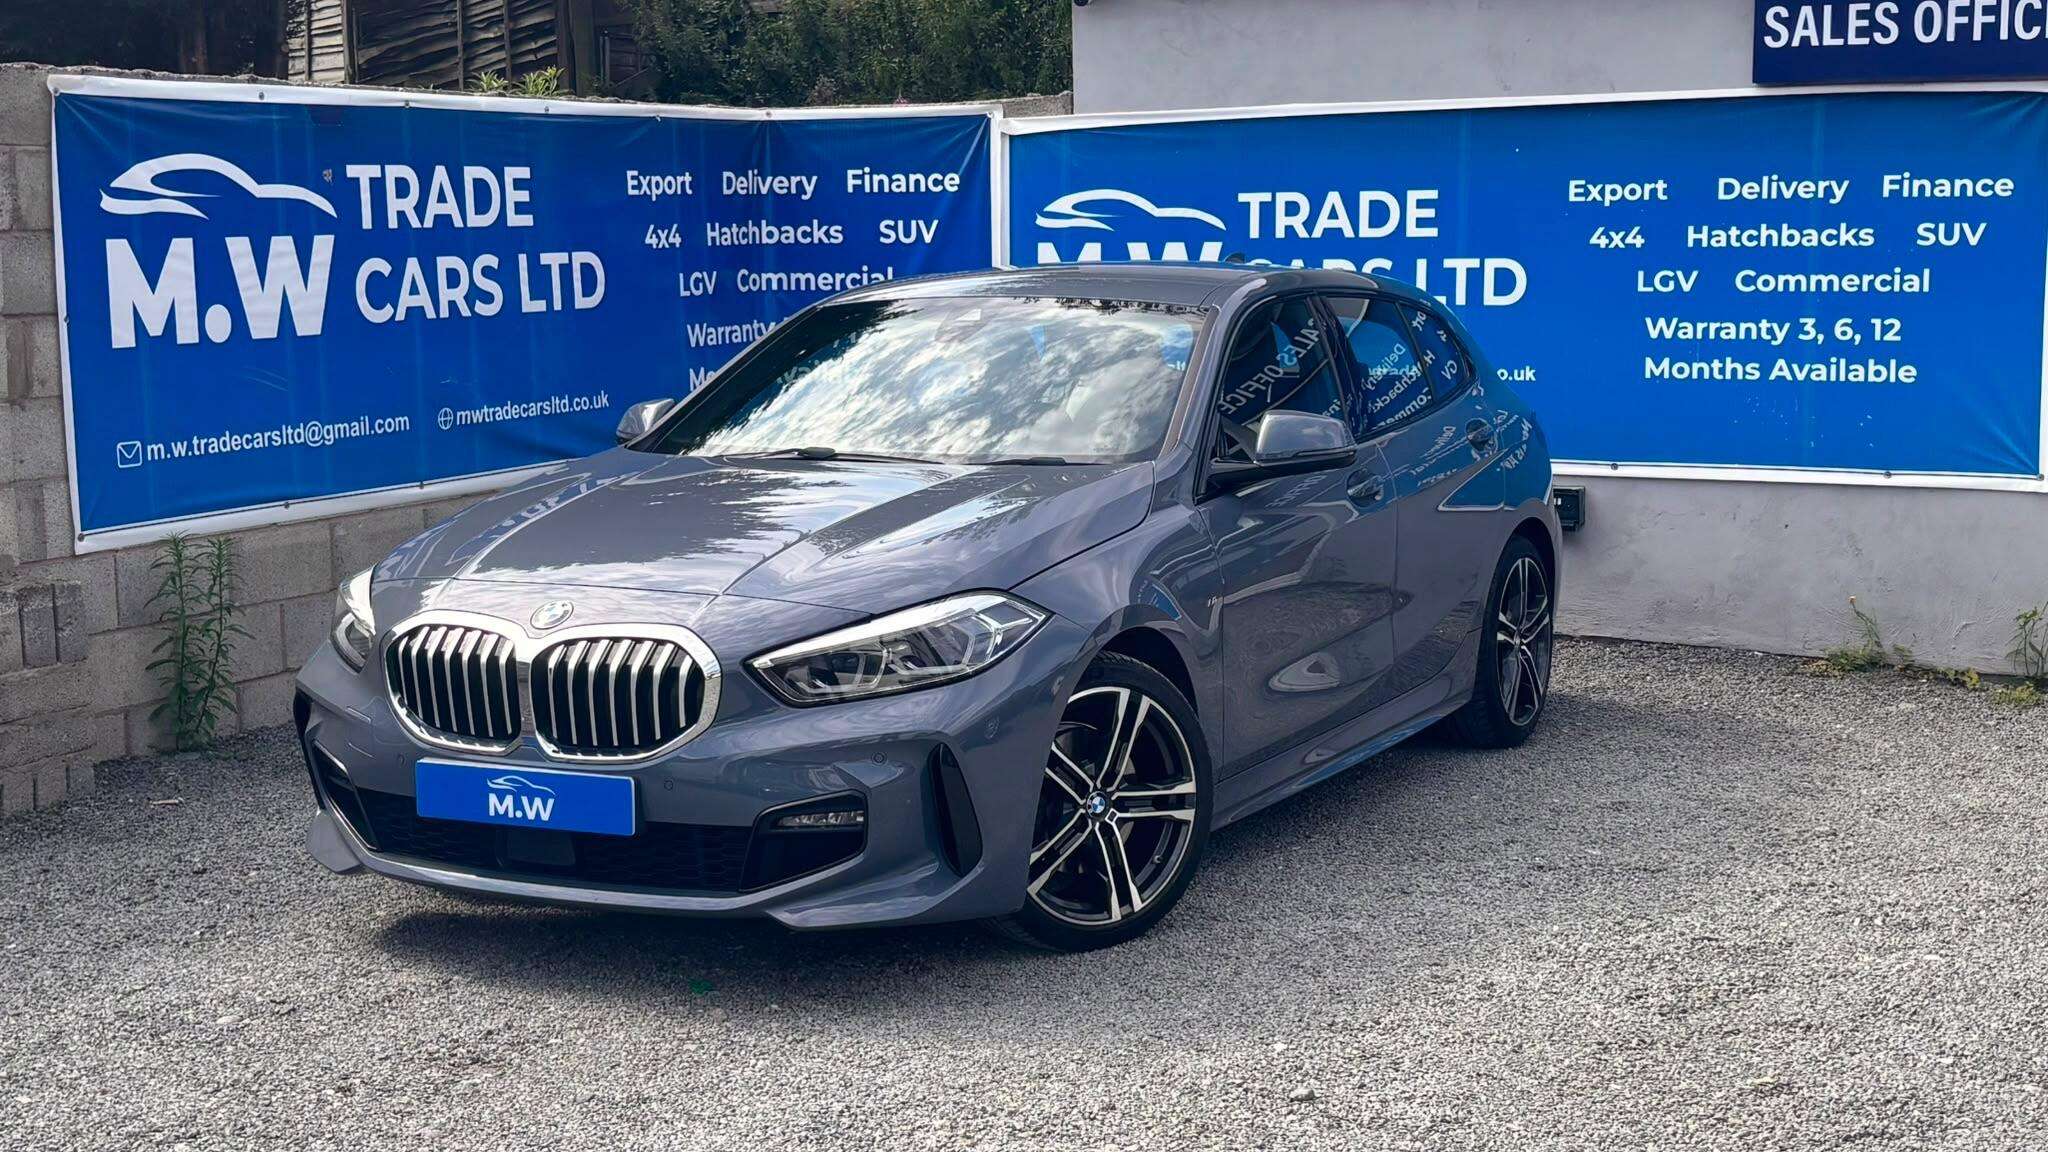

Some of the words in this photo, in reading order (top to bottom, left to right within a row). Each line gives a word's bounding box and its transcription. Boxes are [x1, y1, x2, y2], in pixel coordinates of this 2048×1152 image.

[1763, 1, 1899, 48] SALES
[1913, 0, 2048, 43] OFFIC
[345, 164, 534, 230] TRADE
[626, 170, 693, 201] Export
[722, 169, 818, 200] Delivery
[847, 167, 960, 193] Finance
[1568, 179, 1668, 207] Export
[1718, 174, 1850, 204] Delivery
[1882, 172, 2014, 198] Finance
[1237, 189, 1439, 239] TRADE
[645, 223, 682, 249] 4x4
[706, 219, 844, 247] Hatchbacks
[879, 219, 939, 244] SUV
[1589, 226, 1645, 249] 4x4
[1687, 222, 1875, 248] Hatchbacks
[1916, 222, 1987, 246] SUV
[105, 234, 335, 349] M.W
[355, 253, 504, 324] CARS
[518, 251, 606, 313] LTD
[679, 271, 717, 297] LGV
[1415, 257, 1527, 306] LTD
[1637, 270, 1699, 293] LGV
[1735, 267, 1930, 293] Commercial
[1645, 317, 1790, 346] Warranty
[1798, 317, 1825, 345] 3,
[1834, 318, 1862, 345] 6,
[1870, 318, 1901, 341] 12
[1645, 357, 1761, 380] Months
[1768, 356, 1917, 383] Available
[456, 390, 609, 427] mwtradecarsltd.co.uk
[147, 414, 410, 461] m.w.tradecarsltd@gmail.com
[488, 792, 555, 821] M.W
